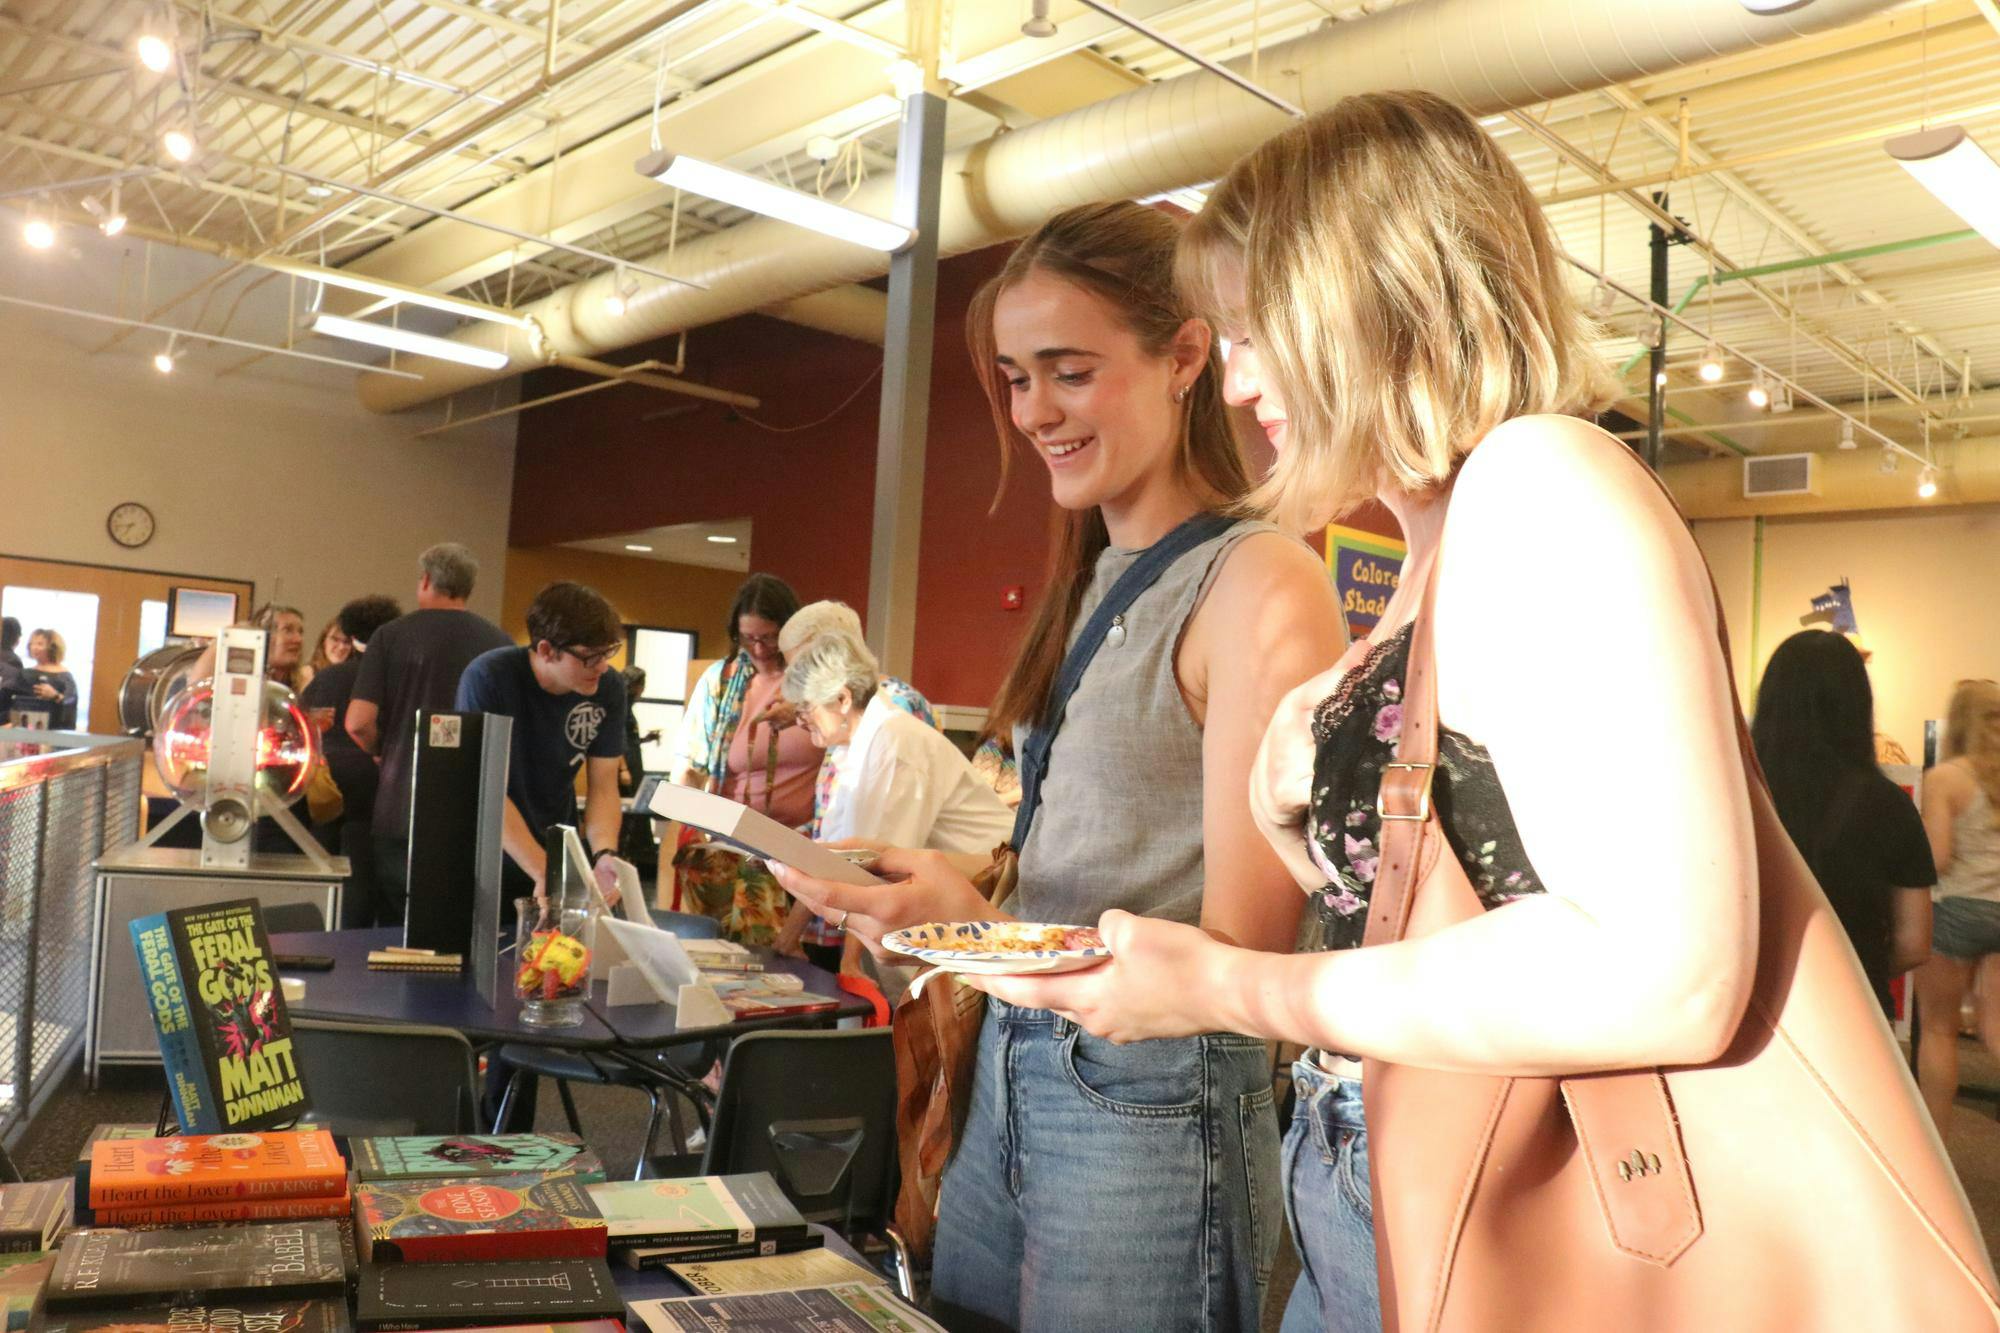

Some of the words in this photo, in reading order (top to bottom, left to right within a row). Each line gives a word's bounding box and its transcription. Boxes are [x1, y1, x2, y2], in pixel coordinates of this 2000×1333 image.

[1351, 558, 1399, 588] Colore
[1345, 588, 1386, 617] Shad
[153, 925, 168, 952] THE
[186, 923, 204, 937] THE
[205, 919, 227, 933] GATE
[227, 917, 238, 930] OF
[238, 914, 255, 928] THE
[190, 926, 262, 971] FERAL
[139, 929, 160, 981] FERAL
[151, 980, 175, 1034] GODS
[160, 952, 177, 985] GATE
[198, 959, 274, 1005] GODS
[168, 985, 182, 1007] OF
[173, 1003, 189, 1031] THE
[218, 1037, 298, 1101] MATT
[226, 1080, 304, 1126] DINNIMAN
[103, 1146, 135, 1173] Heart
[101, 1186, 152, 1202] Heart
[154, 1184, 182, 1199] the
[187, 1183, 232, 1198] Lover
[249, 1181, 280, 1194] LILY
[283, 1179, 319, 1192] KING
[447, 1192, 474, 1215] BONE
[467, 1186, 500, 1219] SEASON
[107, 1209, 154, 1224] Heart
[159, 1208, 186, 1221] the
[191, 1207, 237, 1220] Lover
[253, 1205, 284, 1218] LILY
[287, 1203, 323, 1216] KING
[272, 1228, 306, 1274] BABEL
